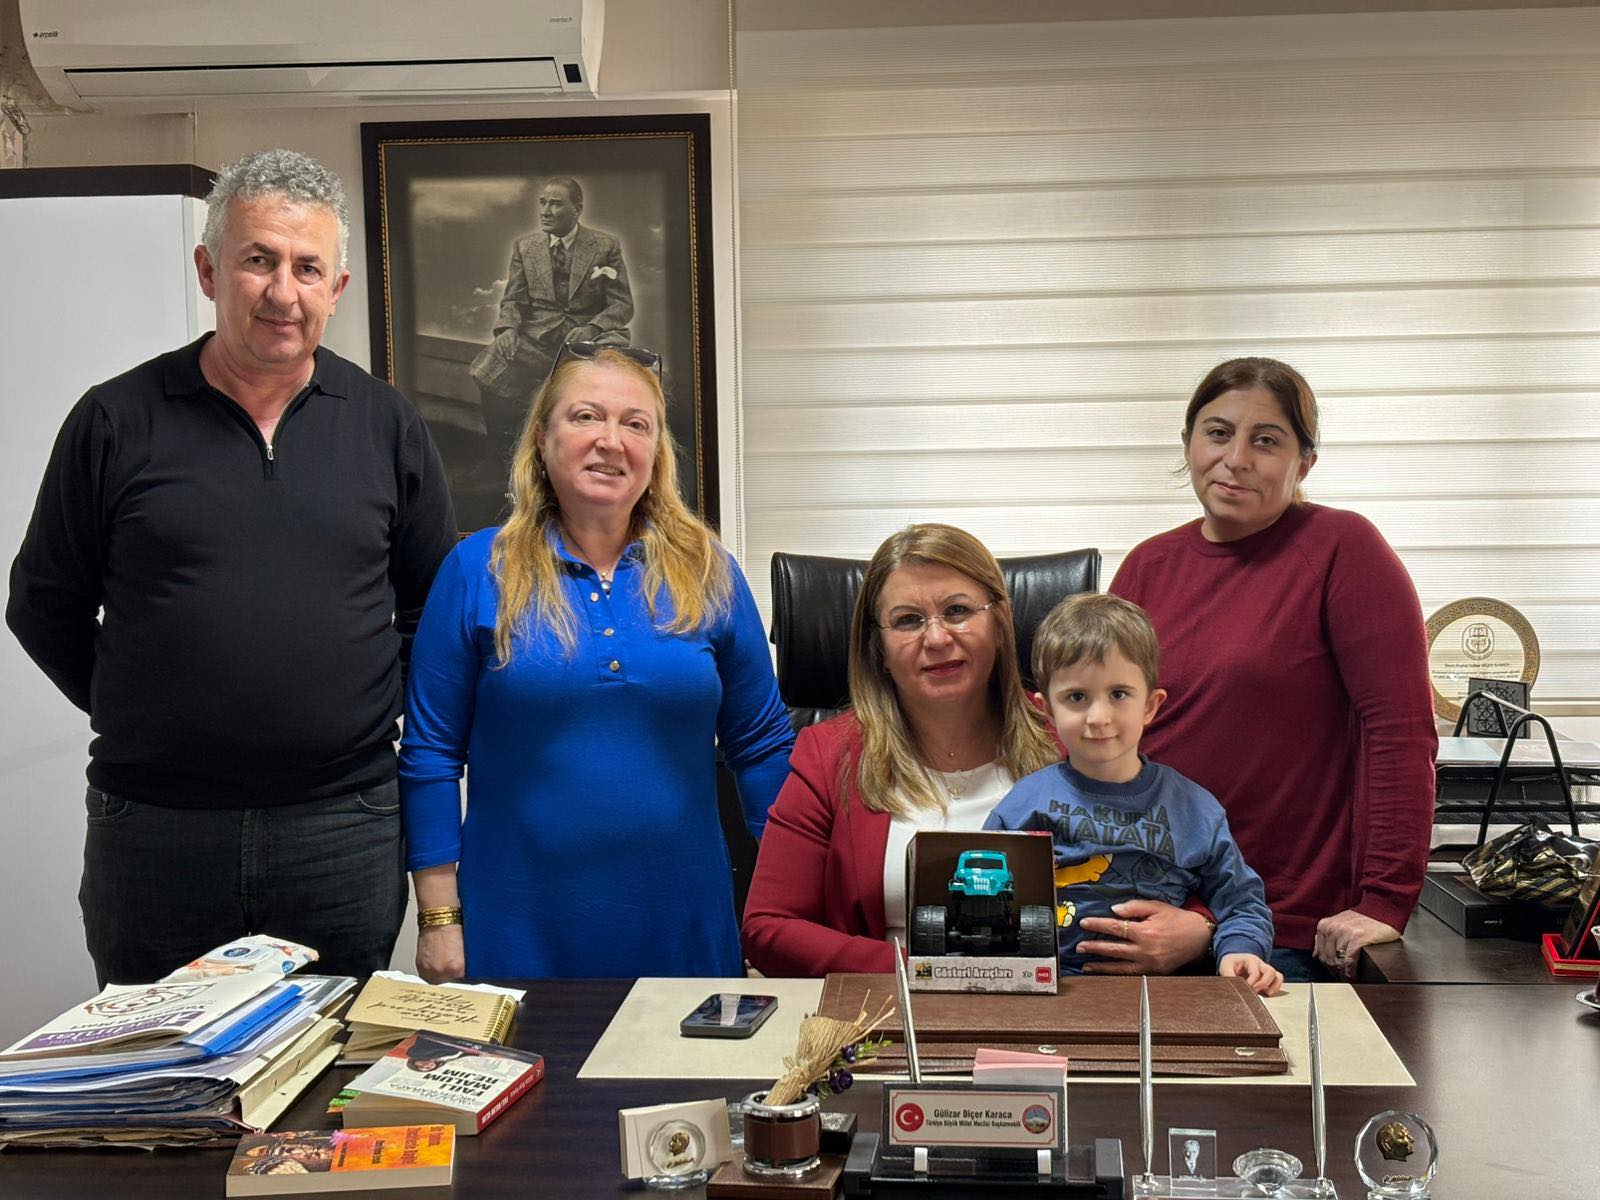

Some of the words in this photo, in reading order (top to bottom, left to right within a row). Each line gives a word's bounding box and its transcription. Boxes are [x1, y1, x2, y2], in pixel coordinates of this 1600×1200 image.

[934, 966, 971, 978] Gösteri
[934, 1108, 960, 1119] Gülizar
[963, 1109, 983, 1120] Biçer
[985, 1110, 1012, 1119] Karaca
